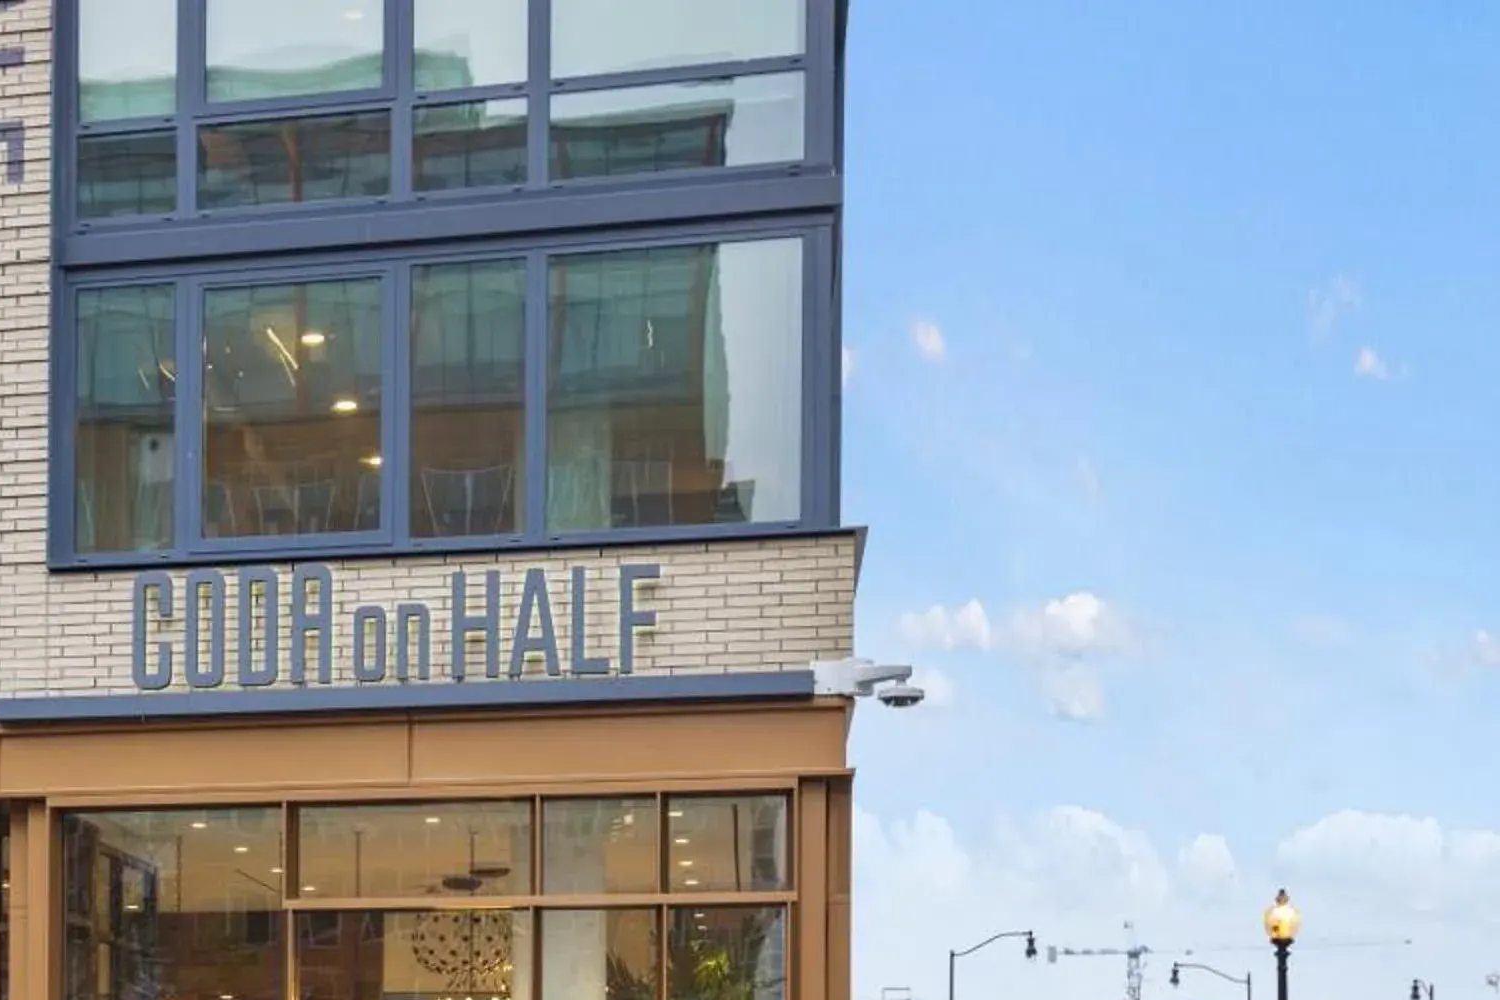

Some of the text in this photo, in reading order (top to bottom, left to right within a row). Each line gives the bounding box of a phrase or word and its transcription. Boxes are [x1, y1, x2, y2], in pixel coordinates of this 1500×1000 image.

[132, 562, 660, 690] CODA on HALF
